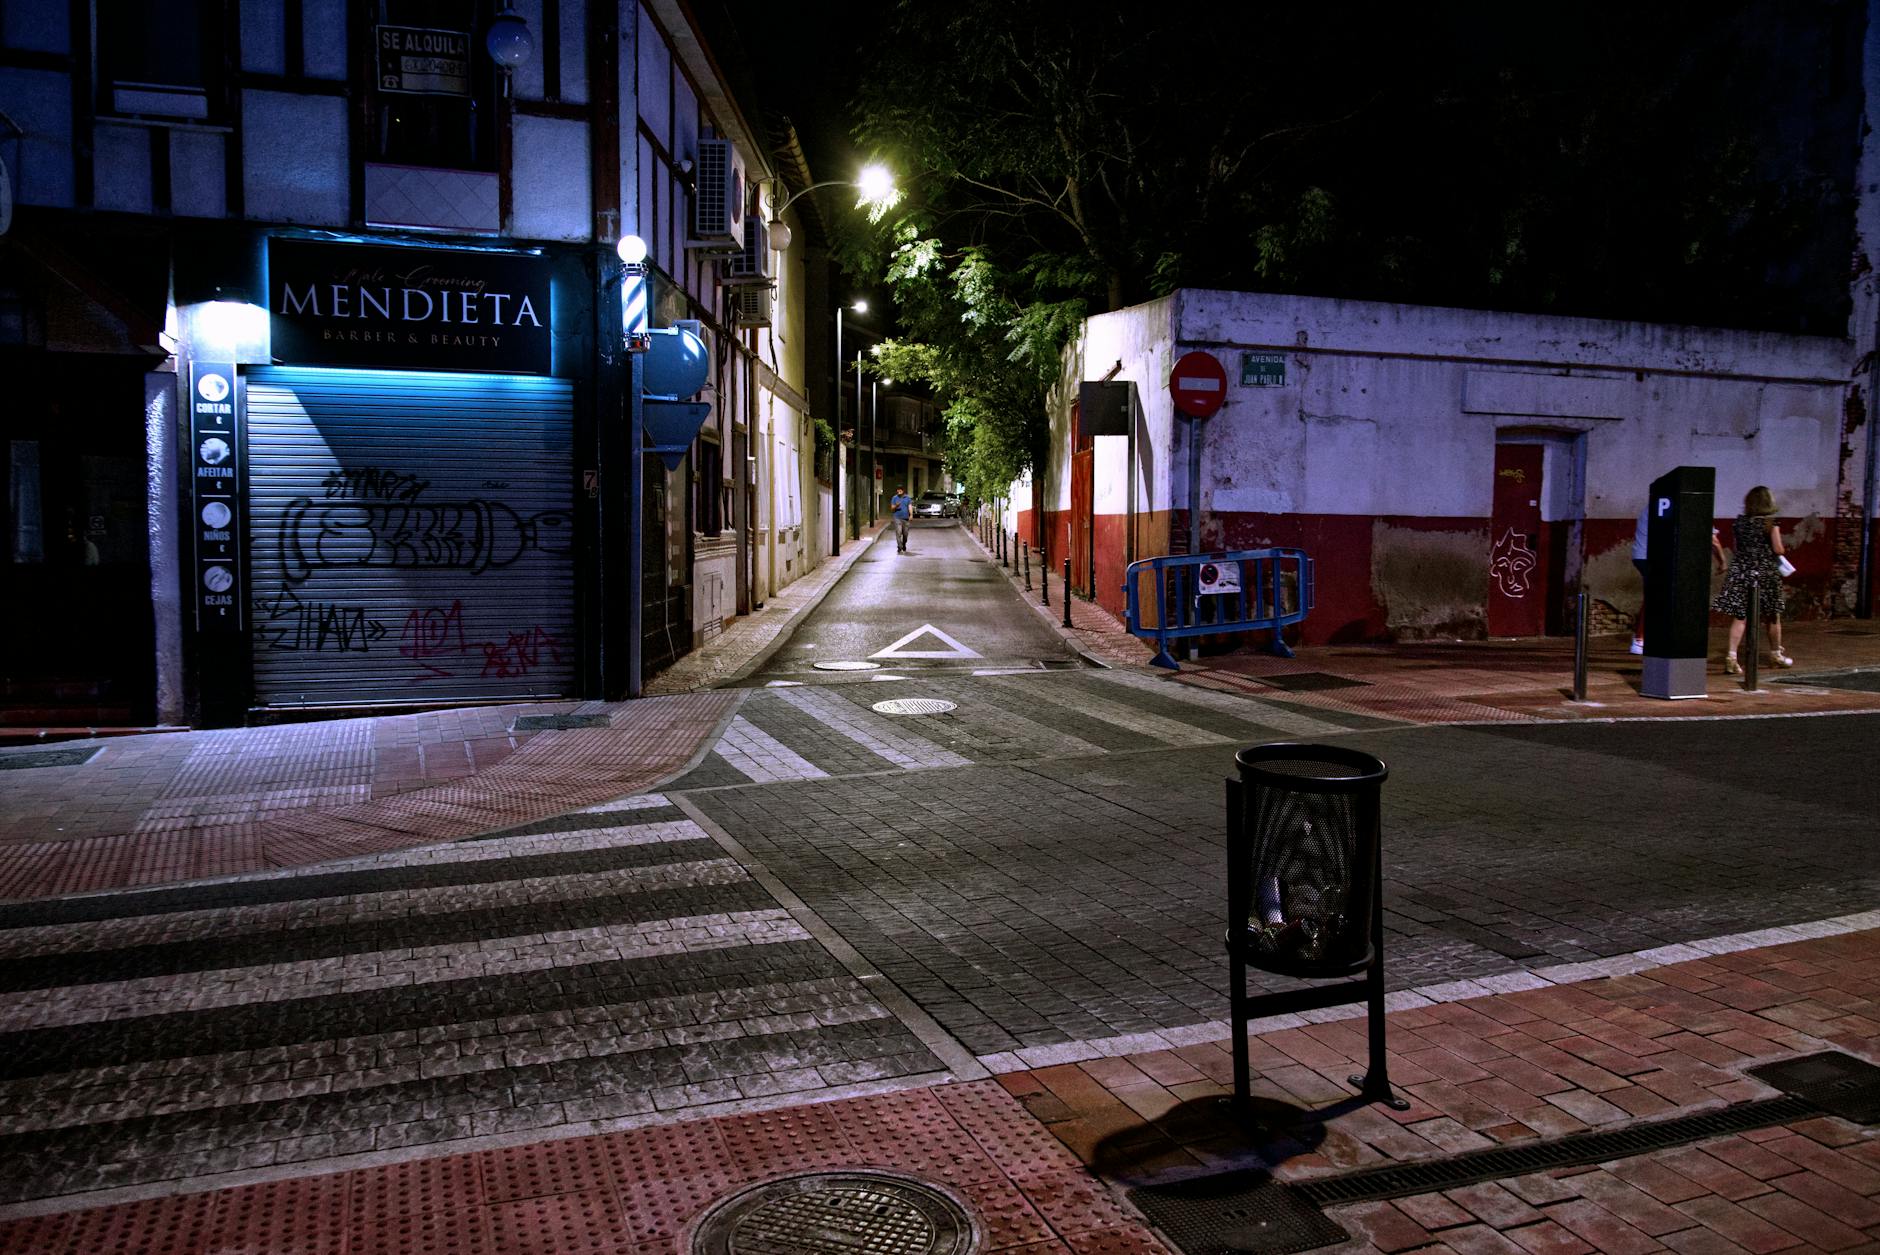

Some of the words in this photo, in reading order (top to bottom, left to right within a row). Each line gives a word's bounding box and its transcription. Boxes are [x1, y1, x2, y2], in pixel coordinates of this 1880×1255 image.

[382, 31, 400, 50] SE
[404, 33, 465, 56] ALQUILA
[396, 264, 488, 292] Grooming
[279, 282, 544, 328] MENDIETA
[323, 328, 397, 343] BARBER
[407, 333, 418, 344] &
[431, 333, 502, 348] BEAUTY
[1250, 355, 1284, 364] AVENIDA
[1243, 374, 1257, 384] JUAN
[1260, 374, 1277, 385] PABLO
[196, 403, 232, 415] CORTAR
[197, 466, 234, 478] AFEITAR
[585, 472, 595, 488] 7
[1657, 497, 1671, 517] P
[203, 528, 231, 541] NIÑOS
[204, 595, 233, 605] CEJAS
